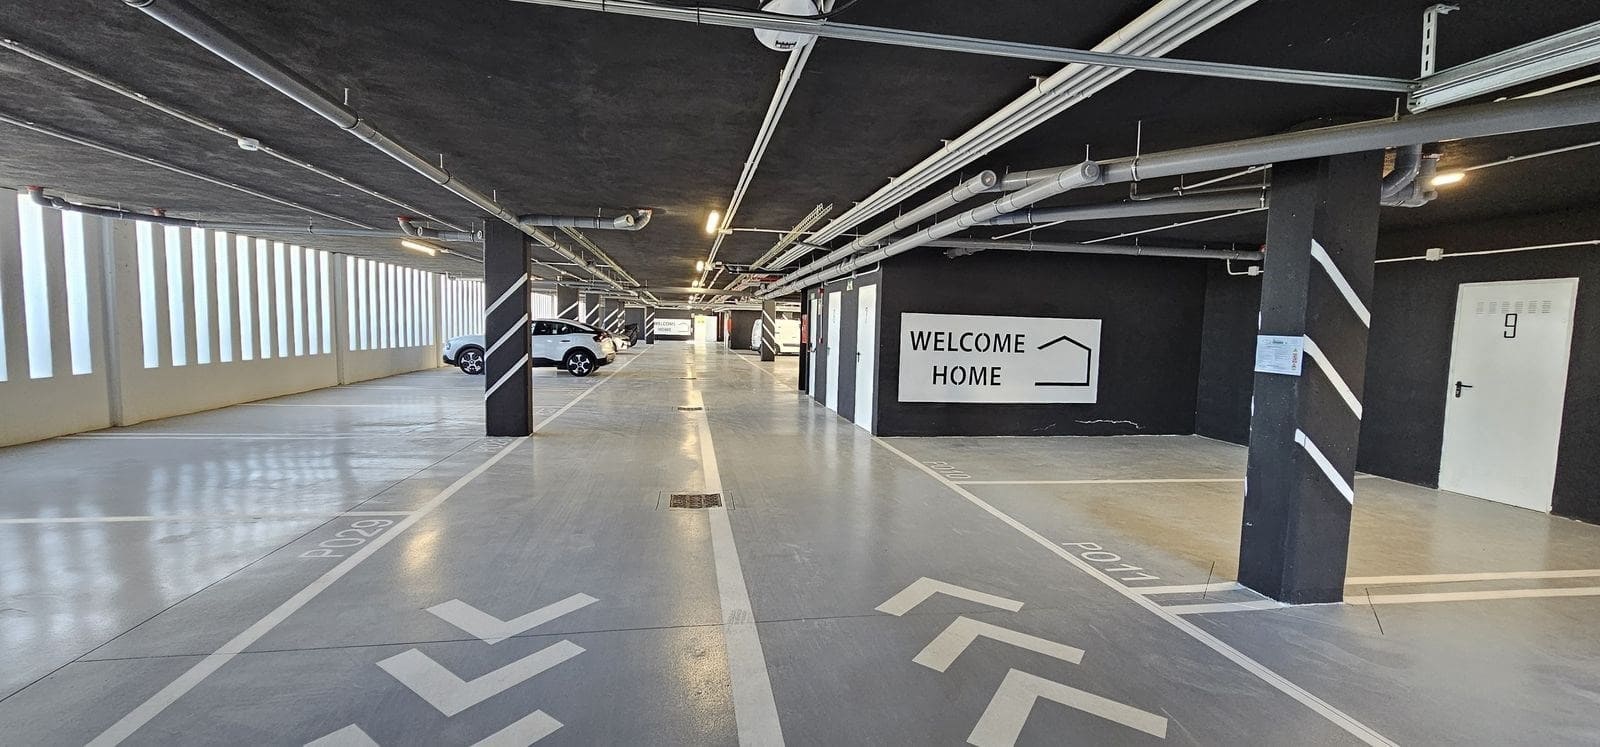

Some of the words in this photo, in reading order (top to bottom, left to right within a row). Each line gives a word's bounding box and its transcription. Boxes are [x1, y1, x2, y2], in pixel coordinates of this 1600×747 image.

[1504, 313, 1518, 338] 9
[910, 331, 1026, 353] WELCOME
[932, 366, 1002, 386] HOME
